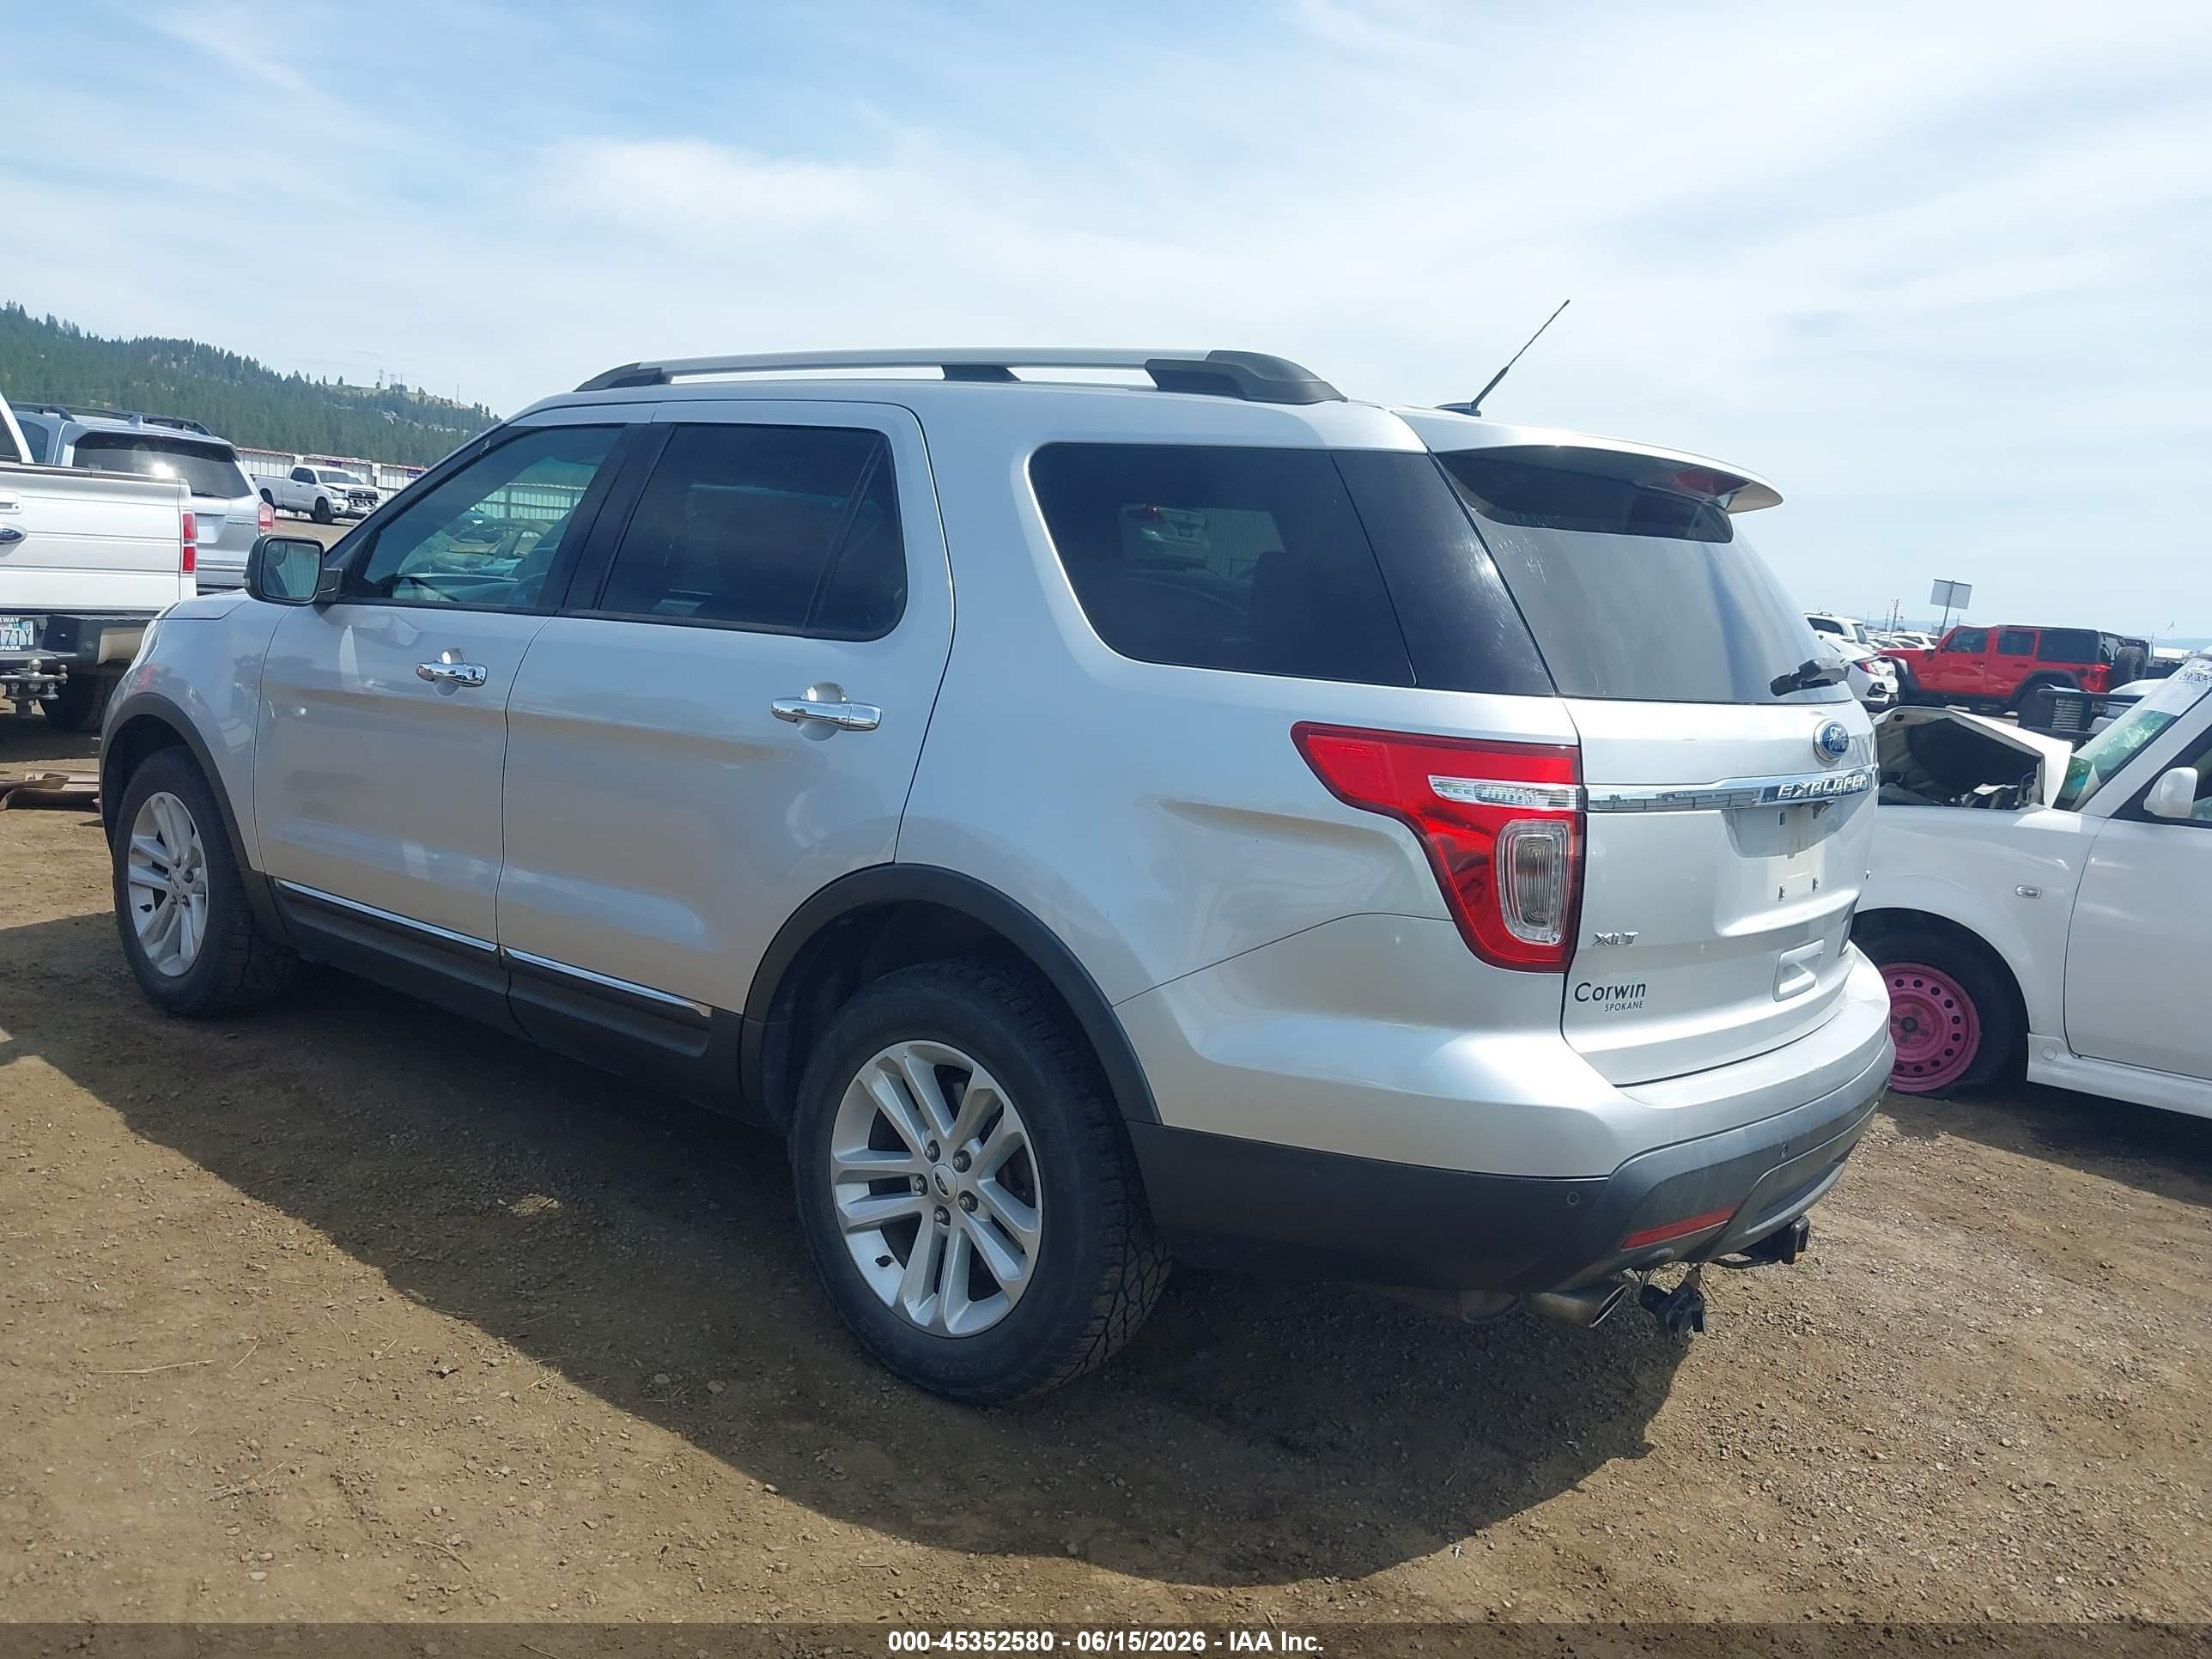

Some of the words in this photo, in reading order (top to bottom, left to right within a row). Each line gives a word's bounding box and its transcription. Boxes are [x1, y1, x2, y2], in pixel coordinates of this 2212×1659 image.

[0, 629, 31, 645] 71Y
[1826, 726, 1848, 750] Ford
[1592, 932, 1639, 947] XLT
[1574, 982, 1646, 1002] Corwin
[1604, 1000, 1644, 1012] SPOKANE
